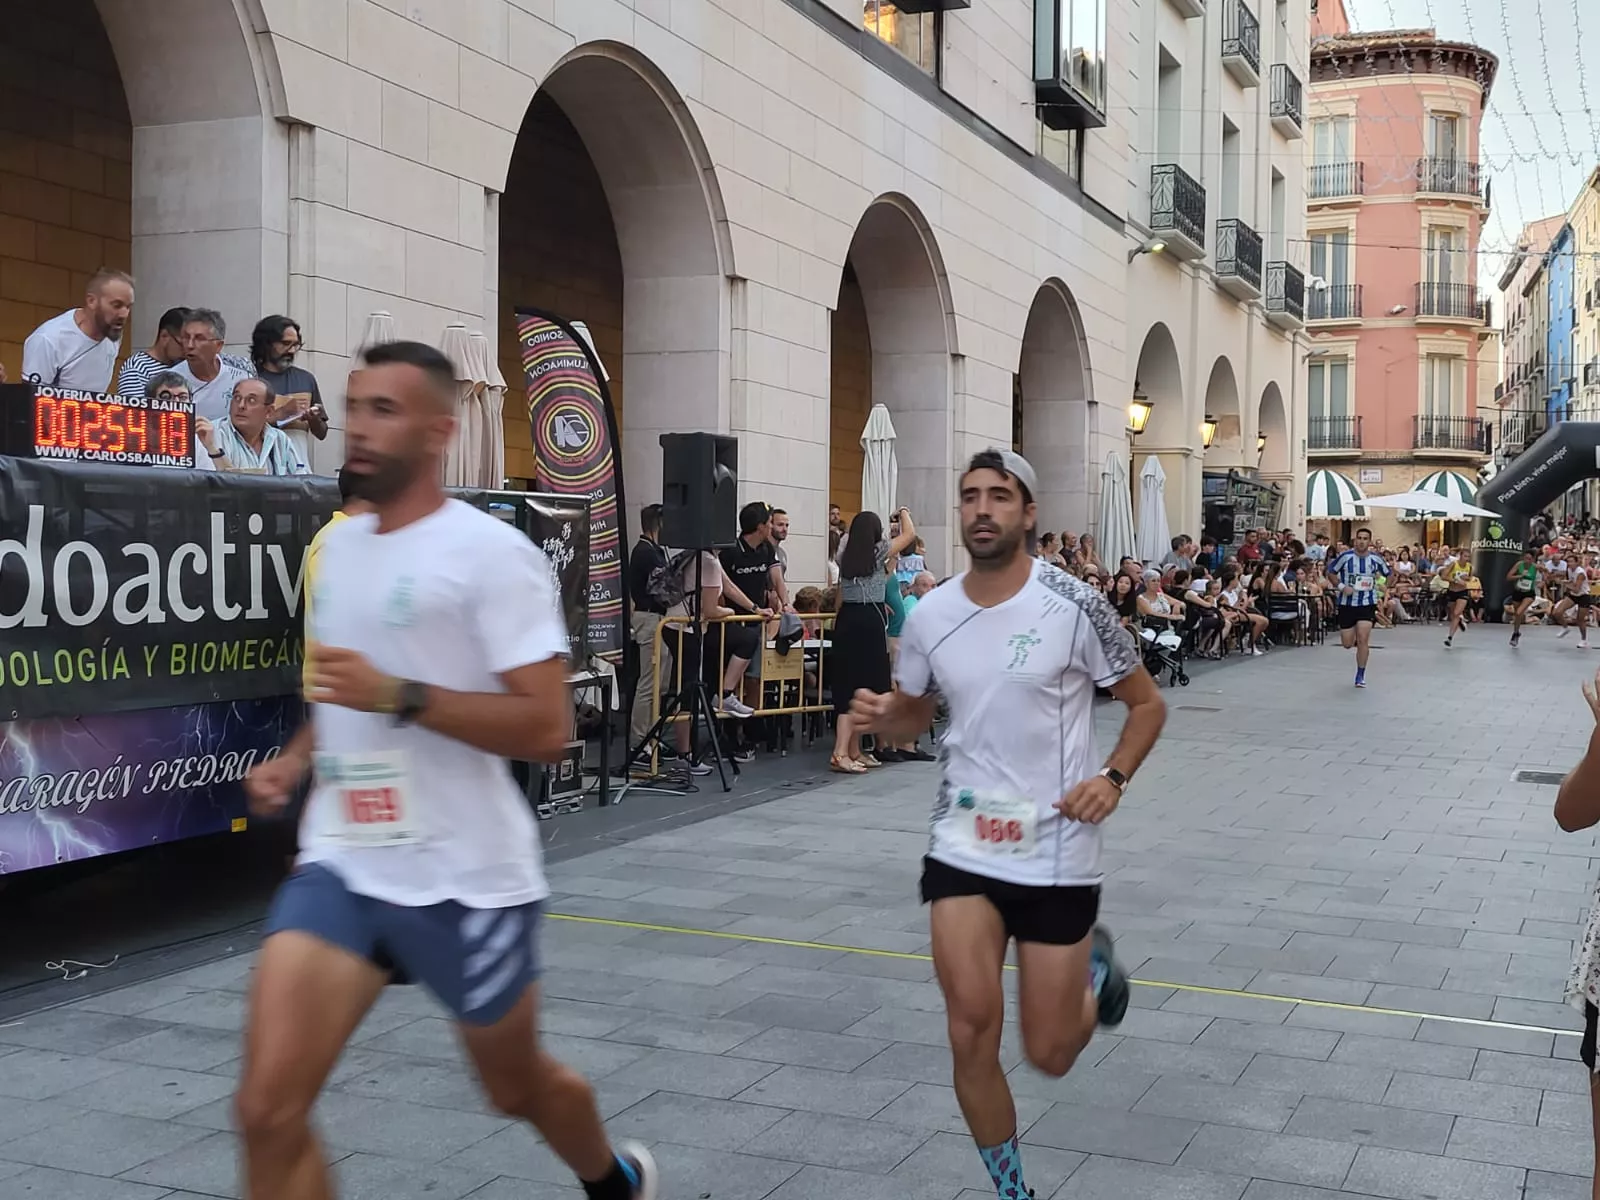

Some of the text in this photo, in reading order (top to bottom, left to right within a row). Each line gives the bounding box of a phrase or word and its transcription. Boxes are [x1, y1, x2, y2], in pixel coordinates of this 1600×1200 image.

[34, 386, 193, 413] JOYERIA CARLOS BAILIN
[34, 446, 193, 467] WWW.CARLOSBAILIN.ES
[1497, 488, 1516, 504] Pisa
[1531, 466, 1548, 477] vive
[1546, 446, 1568, 466] mejor
[1470, 537, 1523, 554] podoactiva
[0, 637, 131, 687] OLOGÍA
[143, 645, 160, 677] Y
[0, 755, 141, 814] ARAGÓN
